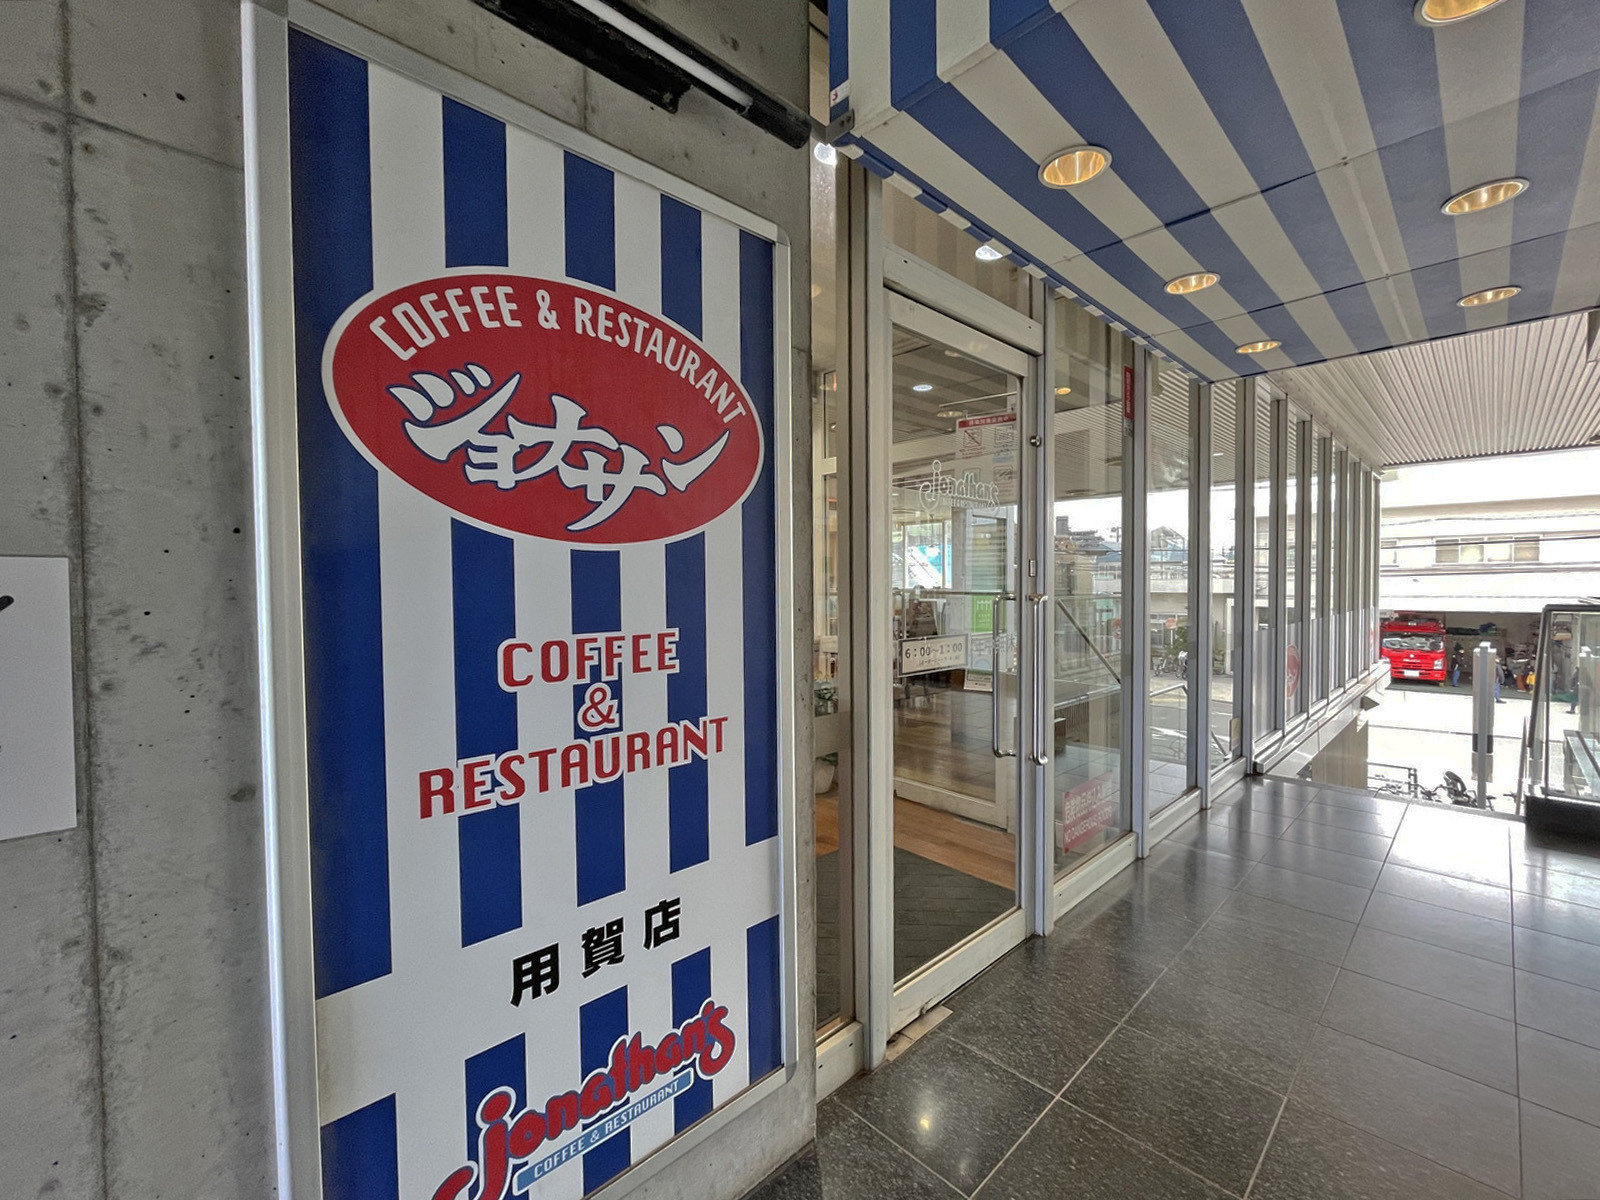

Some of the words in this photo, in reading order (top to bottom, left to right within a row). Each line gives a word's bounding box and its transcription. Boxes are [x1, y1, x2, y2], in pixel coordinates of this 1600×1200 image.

[369, 285, 522, 361] COFFEE
[536, 289, 560, 330] &
[574, 296, 746, 423] RESTAURANT
[388, 363, 730, 532] ジョナサン
[502, 631, 678, 687] COFFEE
[581, 686, 616, 728] &
[419, 716, 728, 820] RESTAURANT
[510, 897, 681, 1008] 用賀店
[533, 1138, 585, 1178] COFFEE
[589, 1130, 600, 1143] &
[604, 1079, 680, 1135] RESTAURANT
